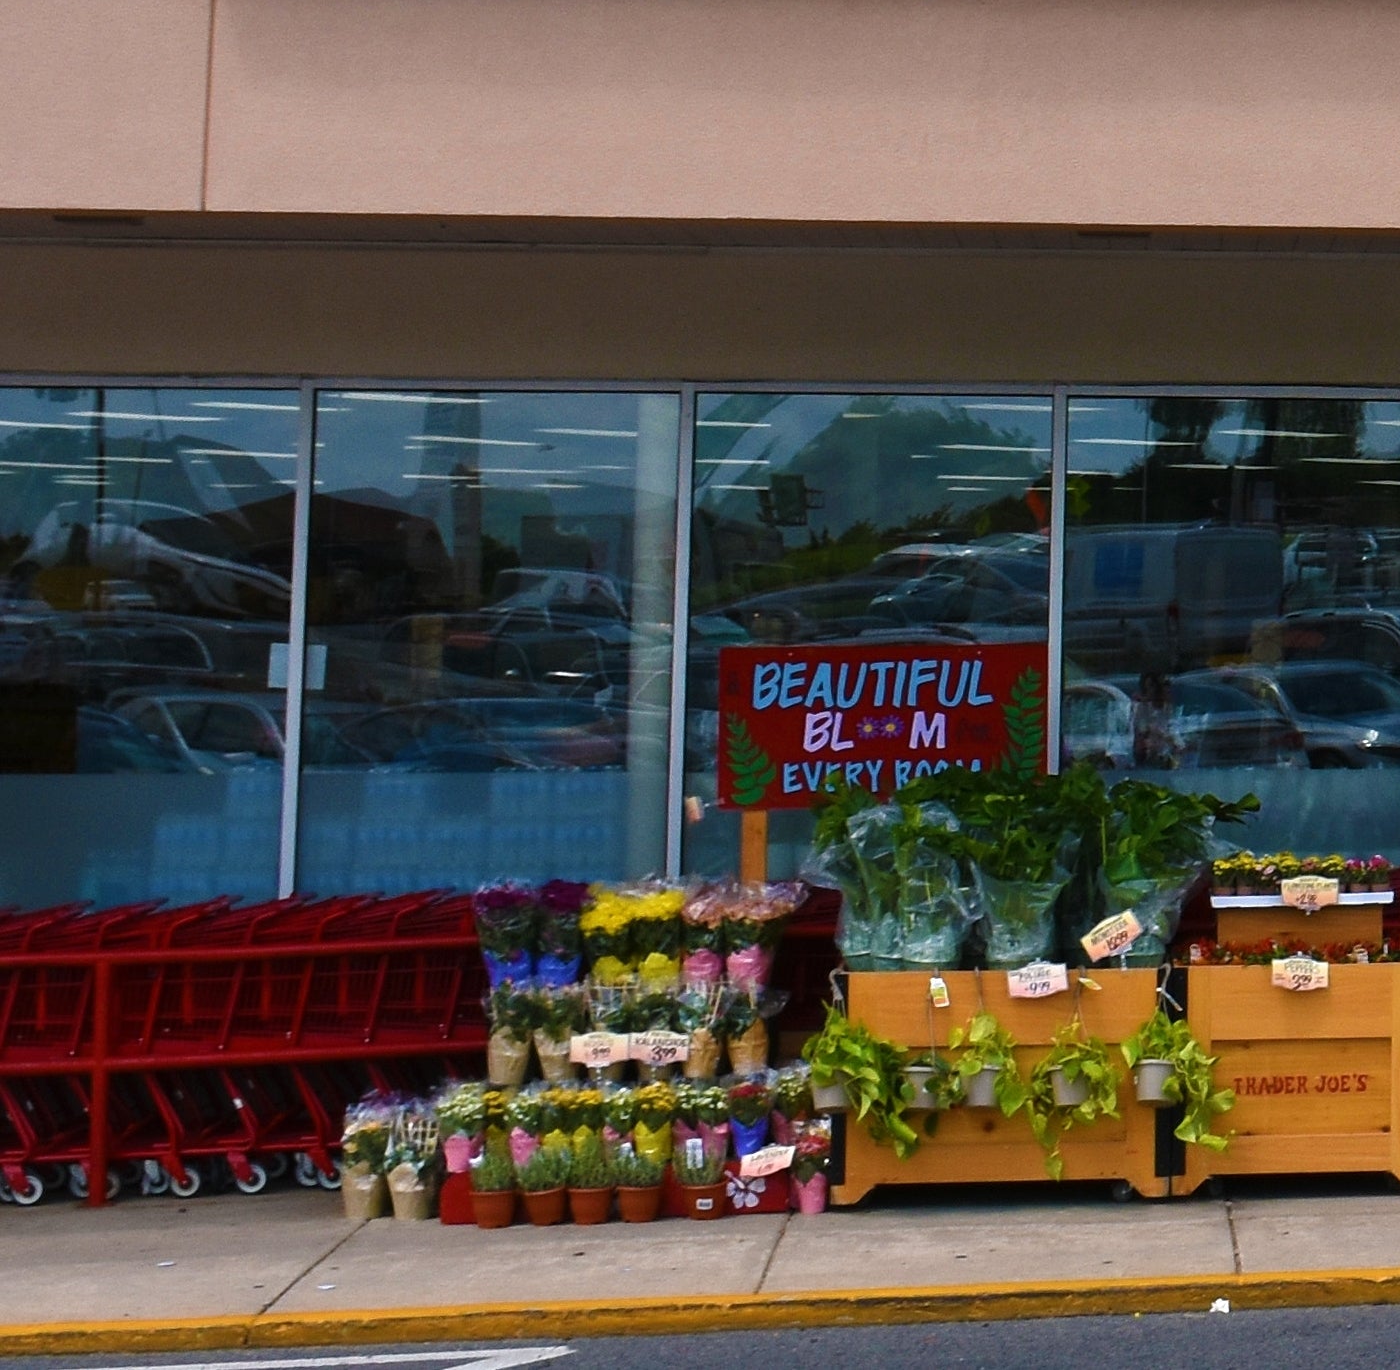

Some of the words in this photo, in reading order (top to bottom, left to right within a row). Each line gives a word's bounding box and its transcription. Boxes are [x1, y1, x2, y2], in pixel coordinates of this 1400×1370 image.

[753, 659, 994, 710] BEAUTIFUL
[783, 759, 883, 794] EVERY
[1234, 1076, 1309, 1095] TRADER
[1315, 1073, 1369, 1093] JOE'S
